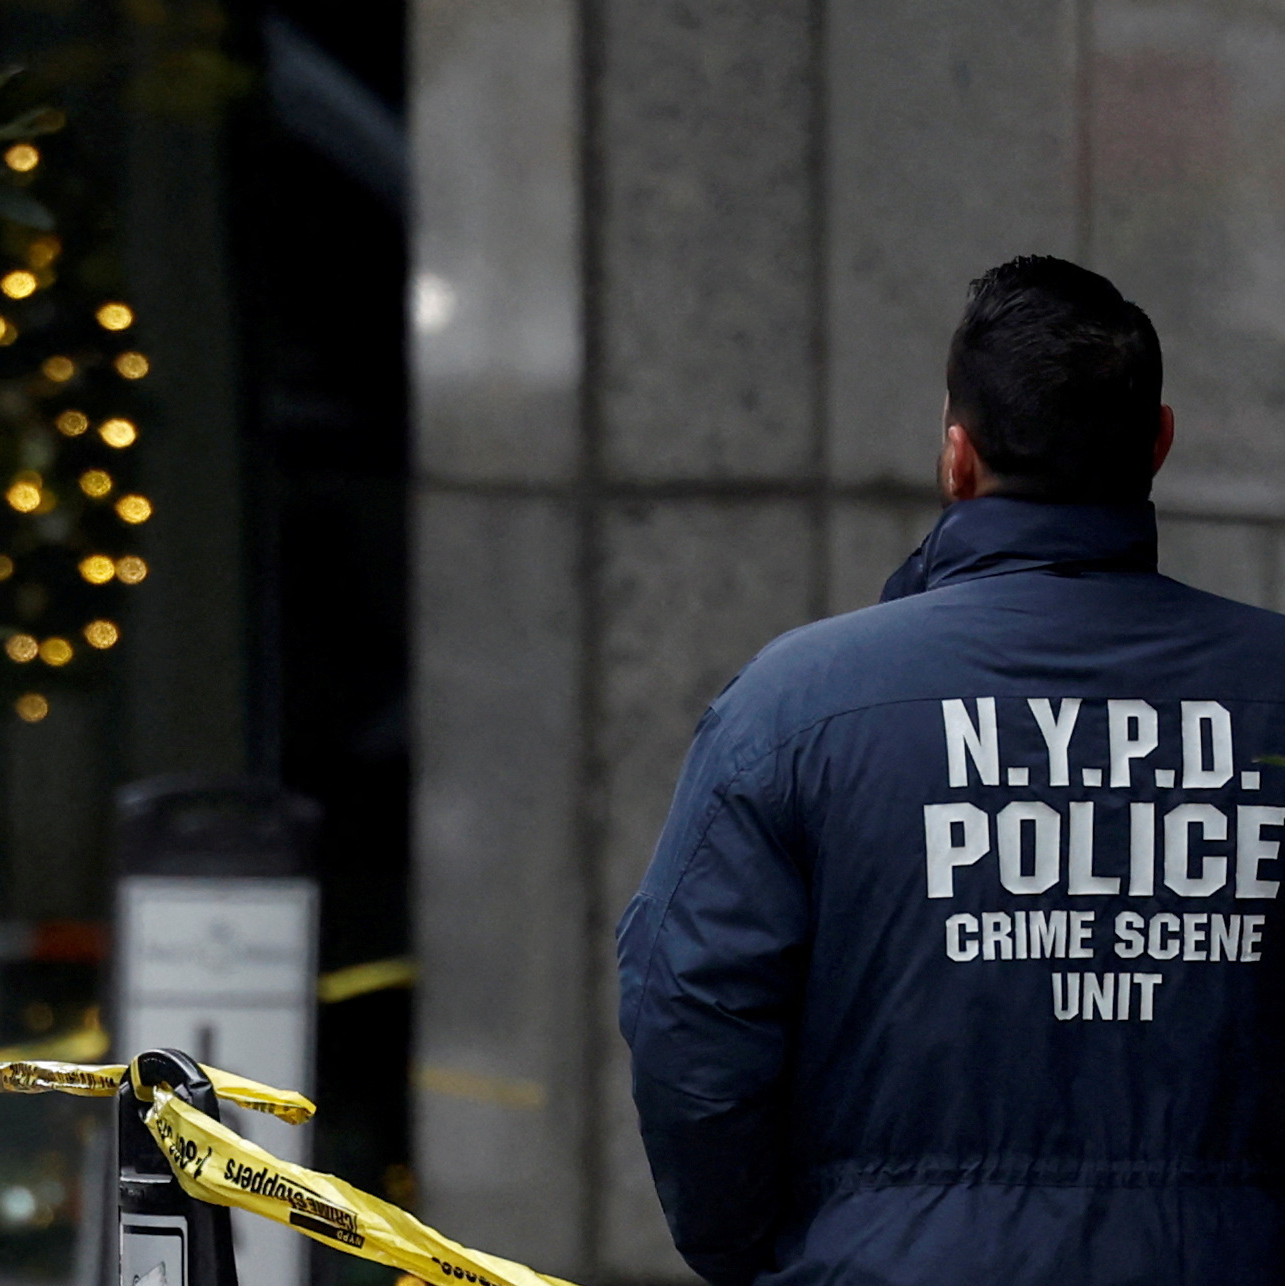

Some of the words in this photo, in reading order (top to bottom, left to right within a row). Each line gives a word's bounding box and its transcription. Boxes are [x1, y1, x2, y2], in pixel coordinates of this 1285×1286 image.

[941, 697, 1261, 790] N.Y.P.D.
[924, 801, 1285, 899] POLICE
[945, 910, 1095, 963] CRIME
[1114, 911, 1266, 963] SCENE
[1051, 972, 1163, 1021] UNIT
